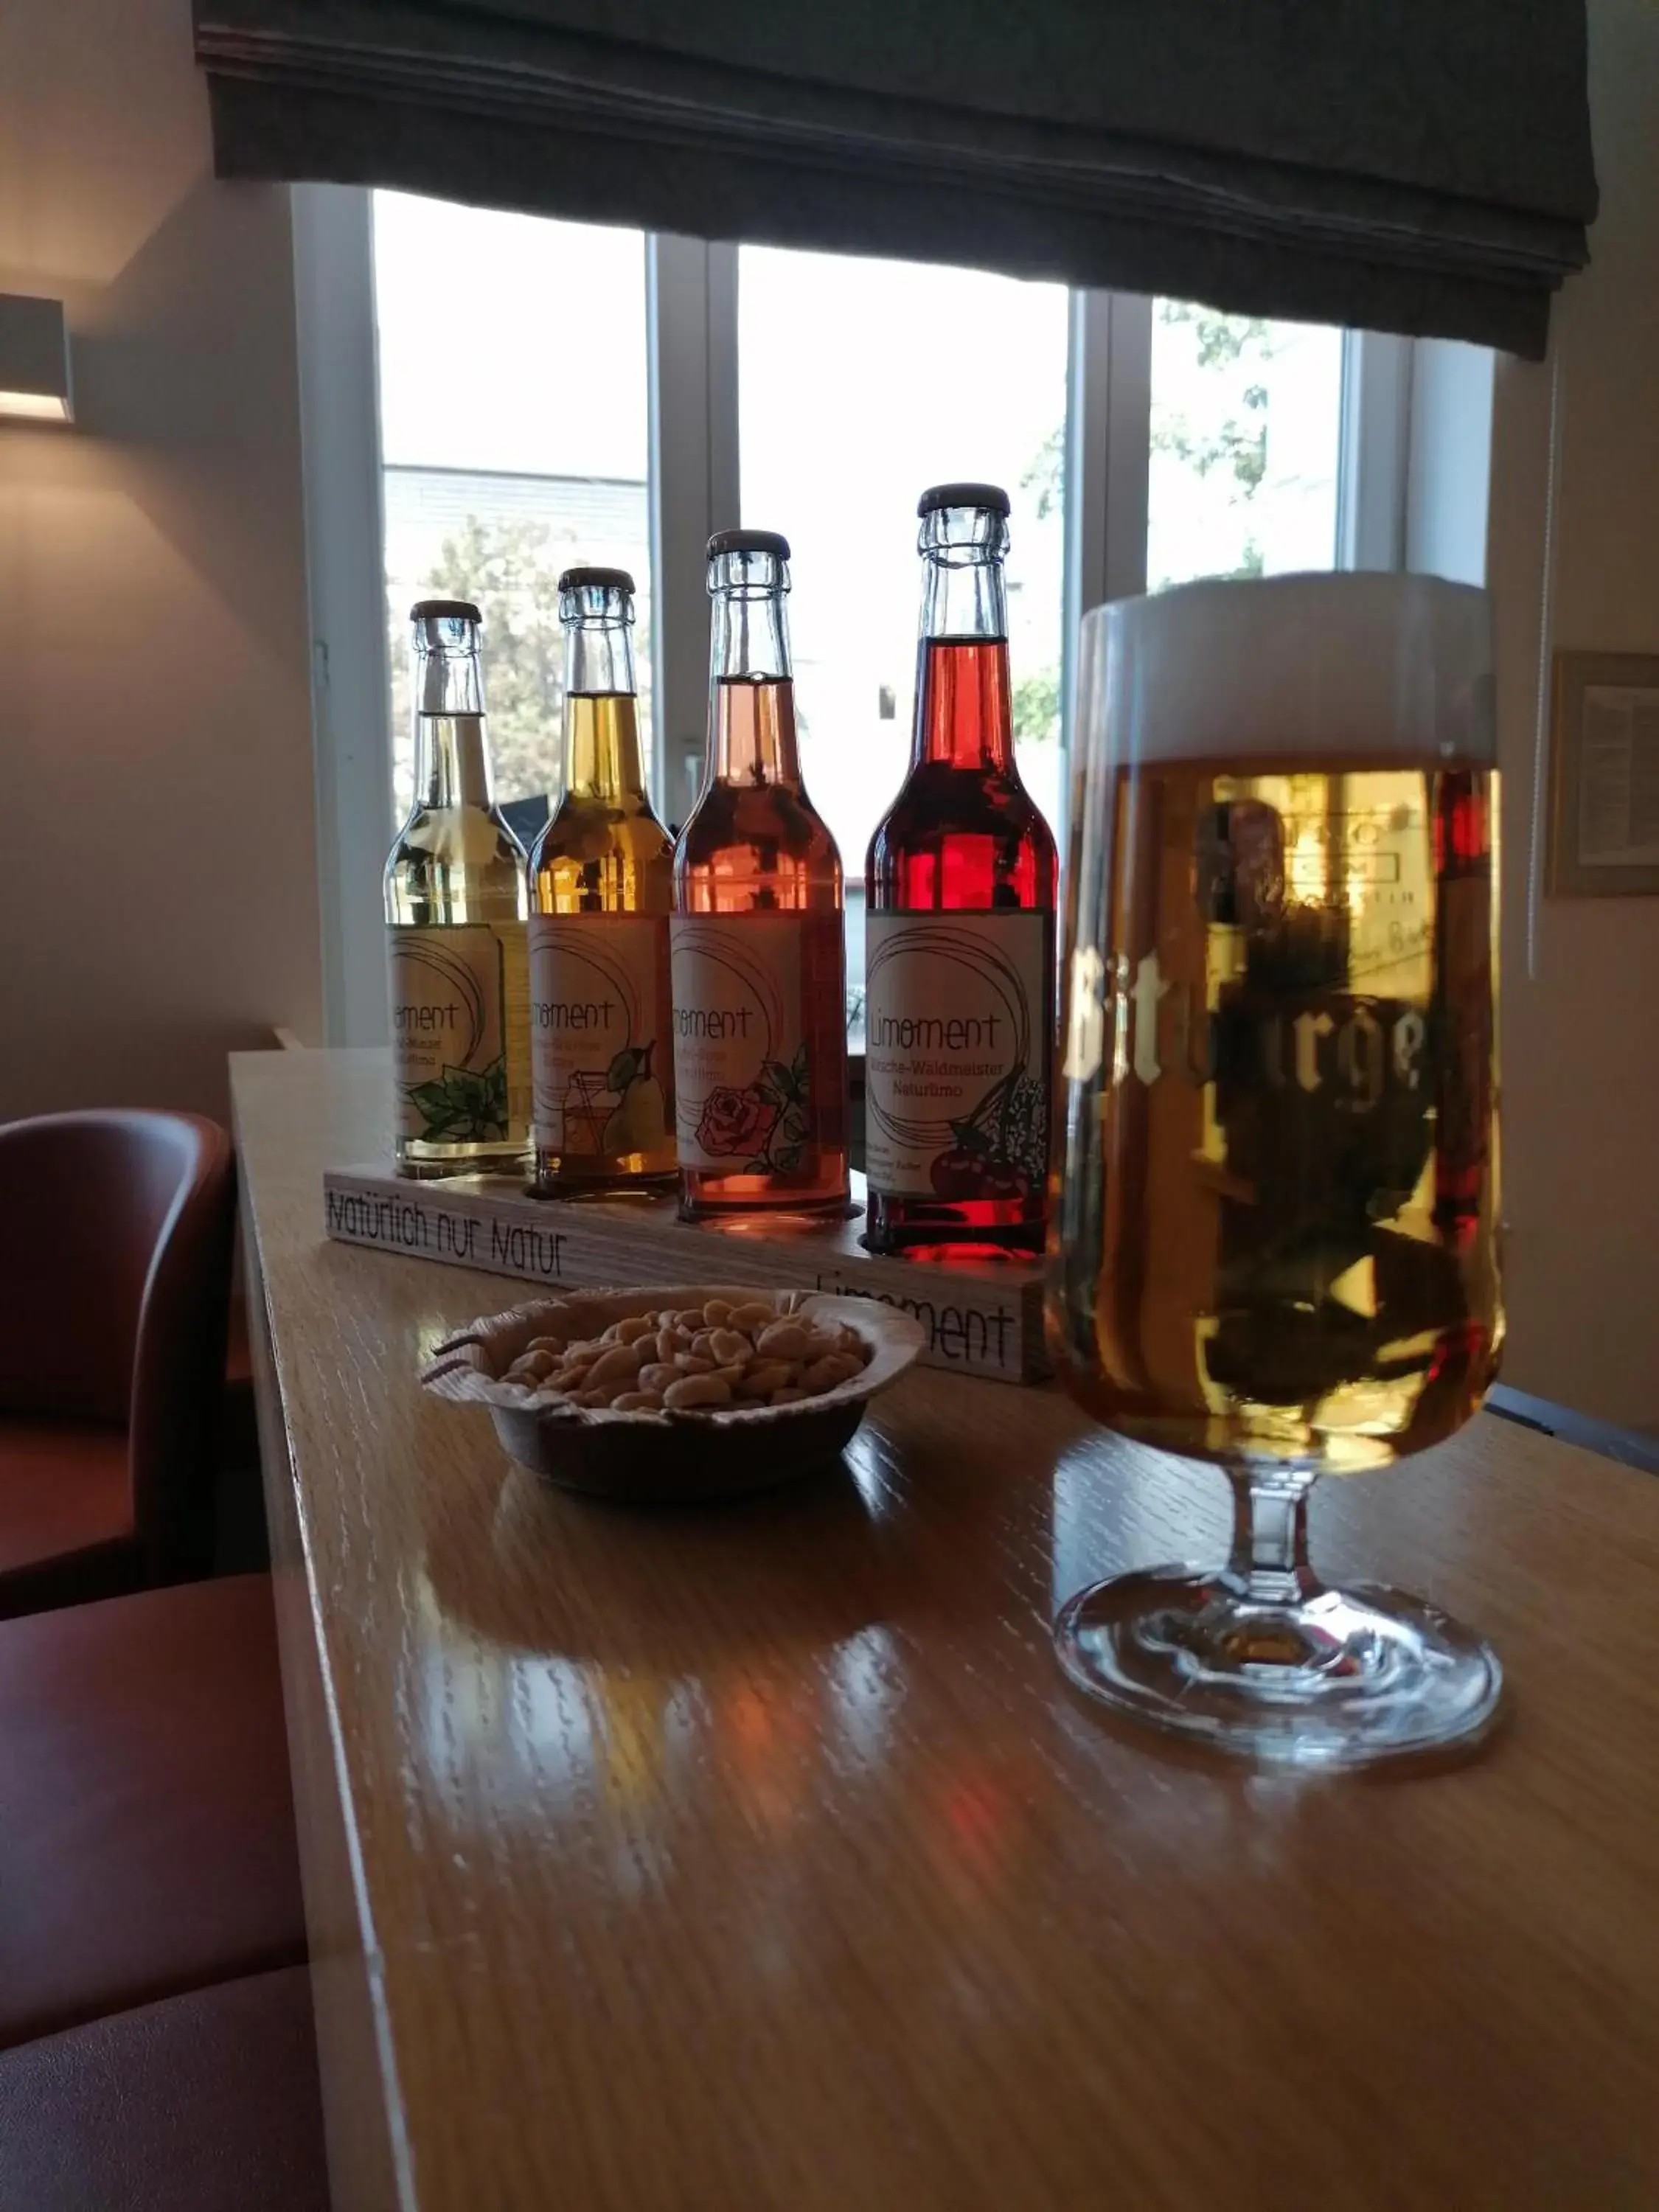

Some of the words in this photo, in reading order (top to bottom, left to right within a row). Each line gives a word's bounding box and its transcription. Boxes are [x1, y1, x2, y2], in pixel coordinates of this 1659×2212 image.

[870, 1007, 1002, 1051] Limoment
[329, 1191, 428, 1248] Natürlich
[437, 1212, 483, 1259] nur
[491, 1217, 568, 1276] Natur
